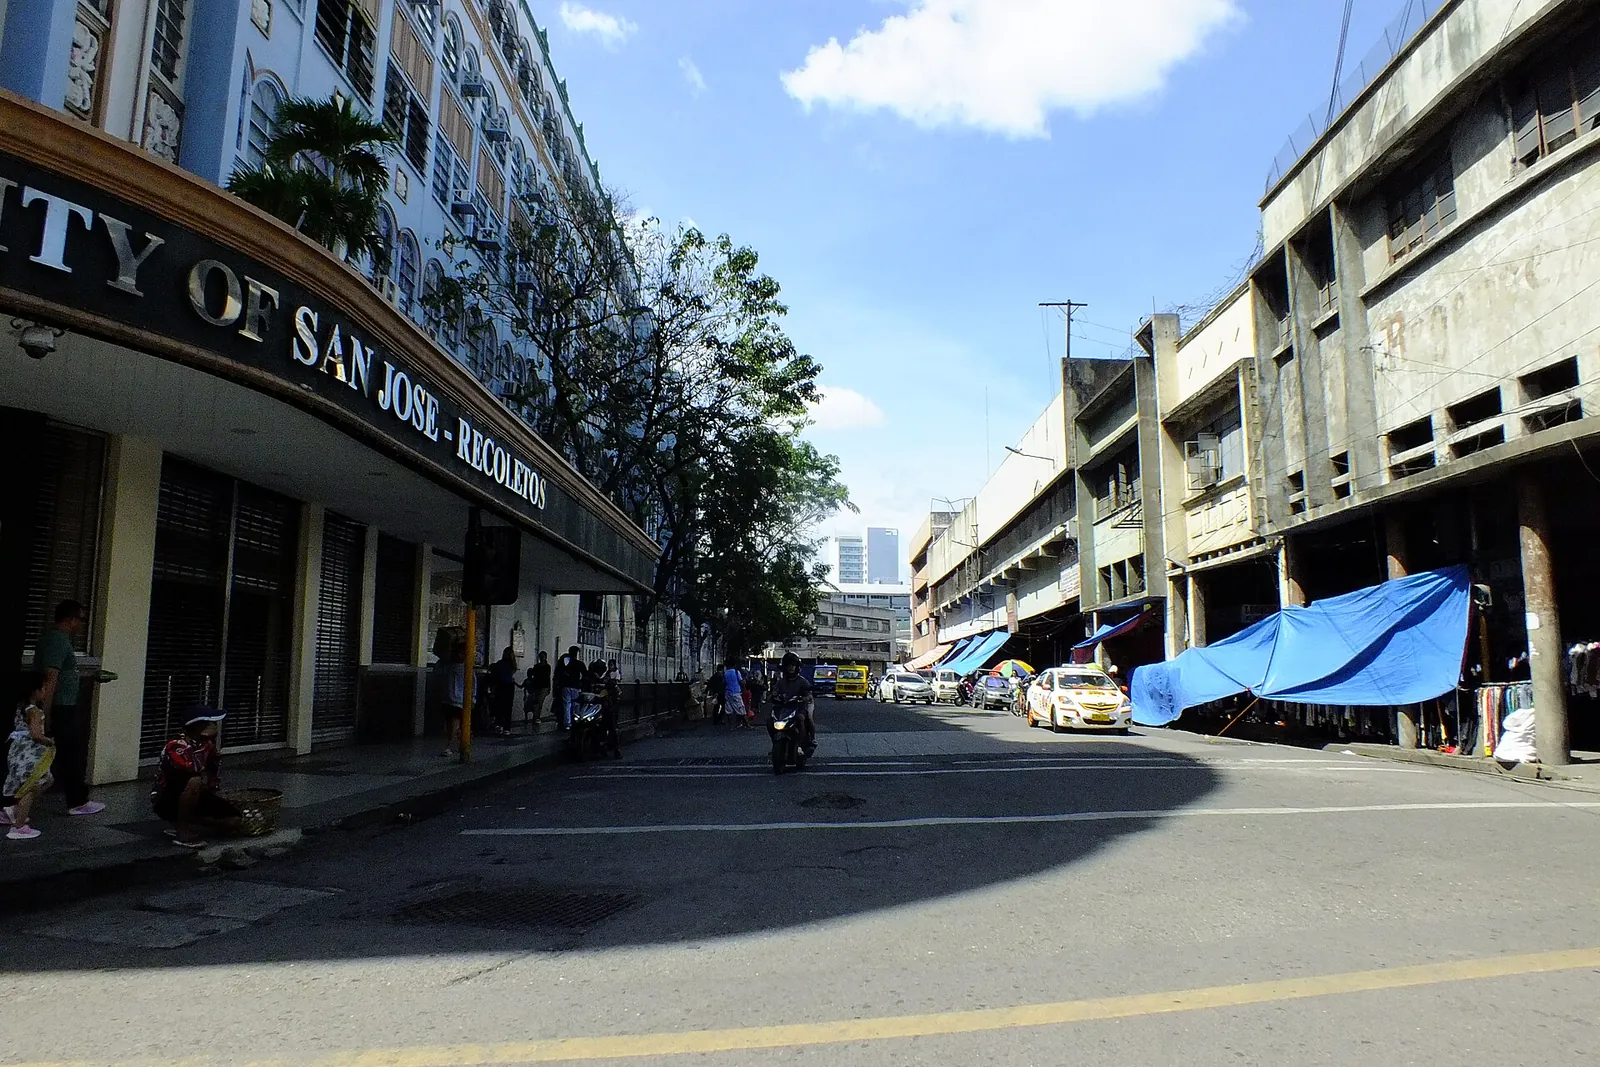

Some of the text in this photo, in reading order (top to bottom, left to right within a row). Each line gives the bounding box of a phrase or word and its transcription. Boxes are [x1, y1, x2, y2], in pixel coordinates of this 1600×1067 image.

[188, 259, 280, 343] OF
[292, 306, 375, 398] SAN
[378, 361, 439, 442] JOSE
[456, 417, 547, 510] RECOLETOS
